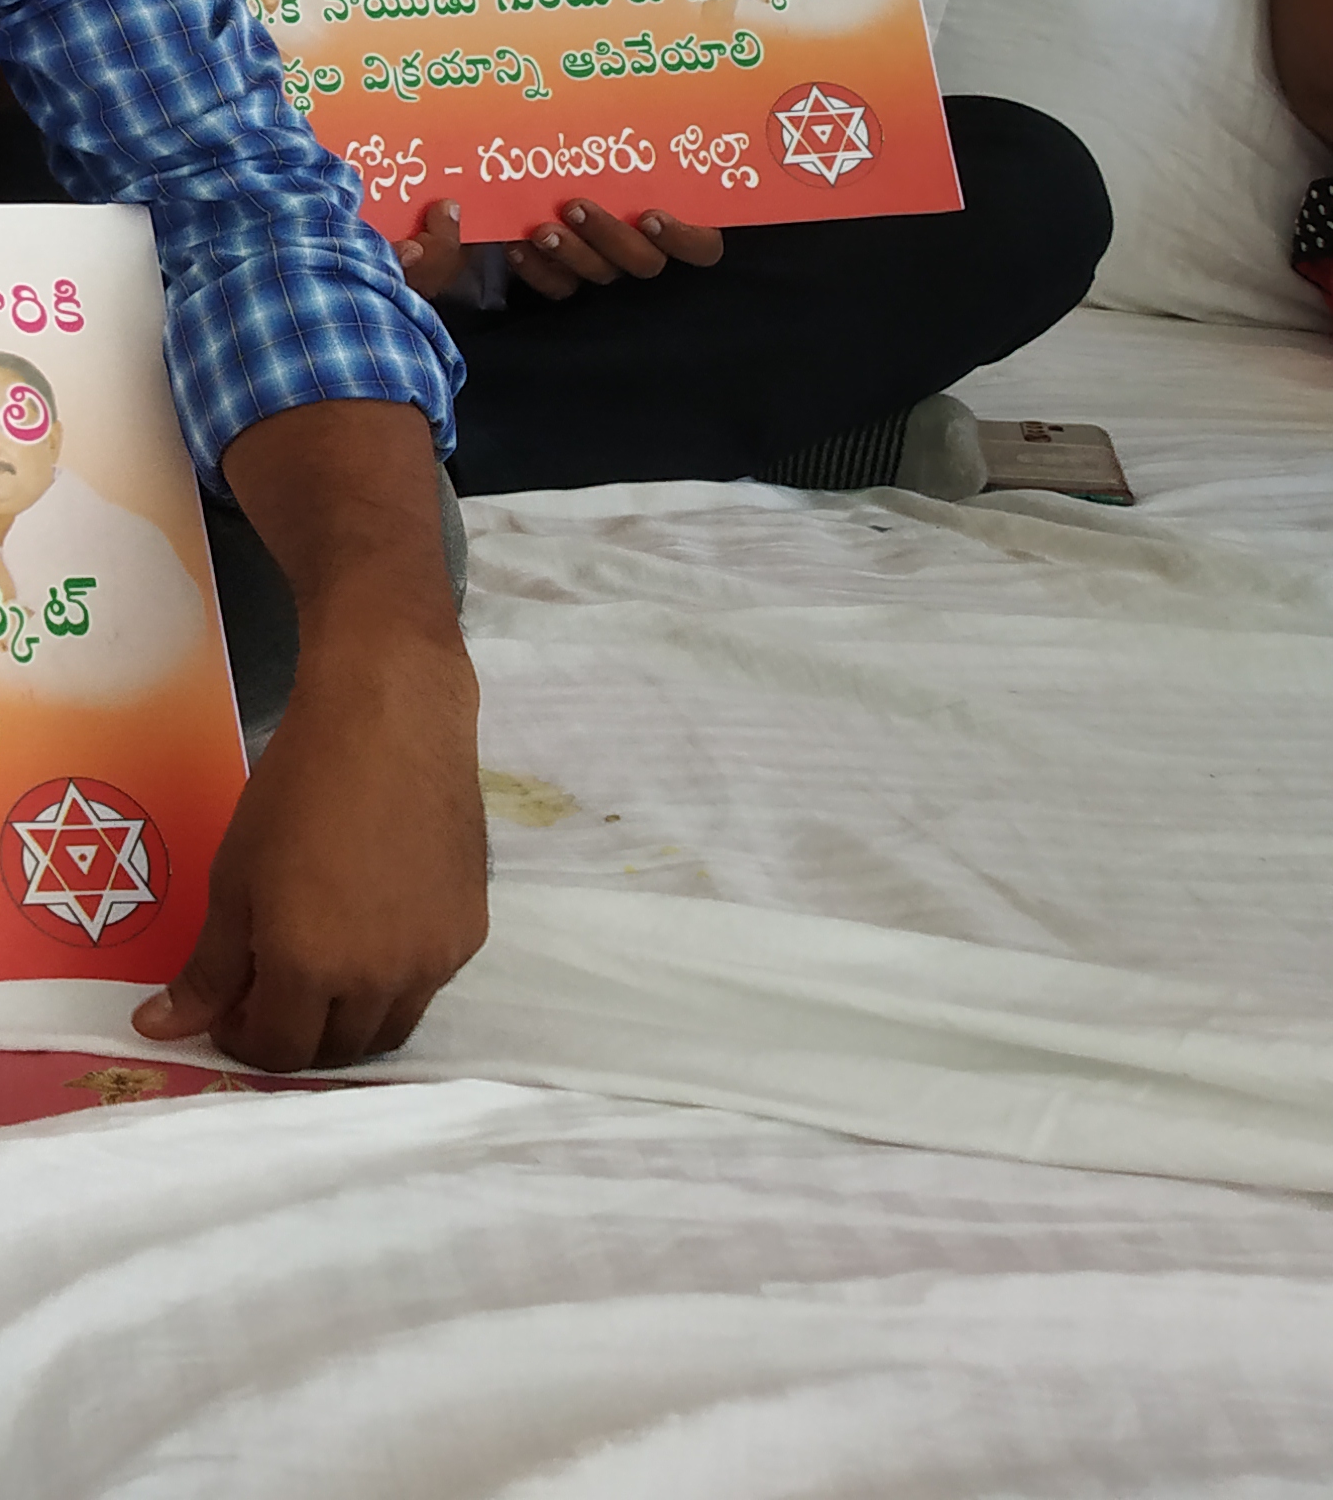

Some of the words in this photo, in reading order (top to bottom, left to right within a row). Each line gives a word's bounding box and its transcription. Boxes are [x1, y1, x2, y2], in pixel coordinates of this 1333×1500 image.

[363, 48, 550, 100] విక్రయాన్ని
[562, 32, 762, 78] ఆపివేయాలి
[478, 127, 656, 182] గుంటూరు
[669, 124, 760, 189] జిల్లా
